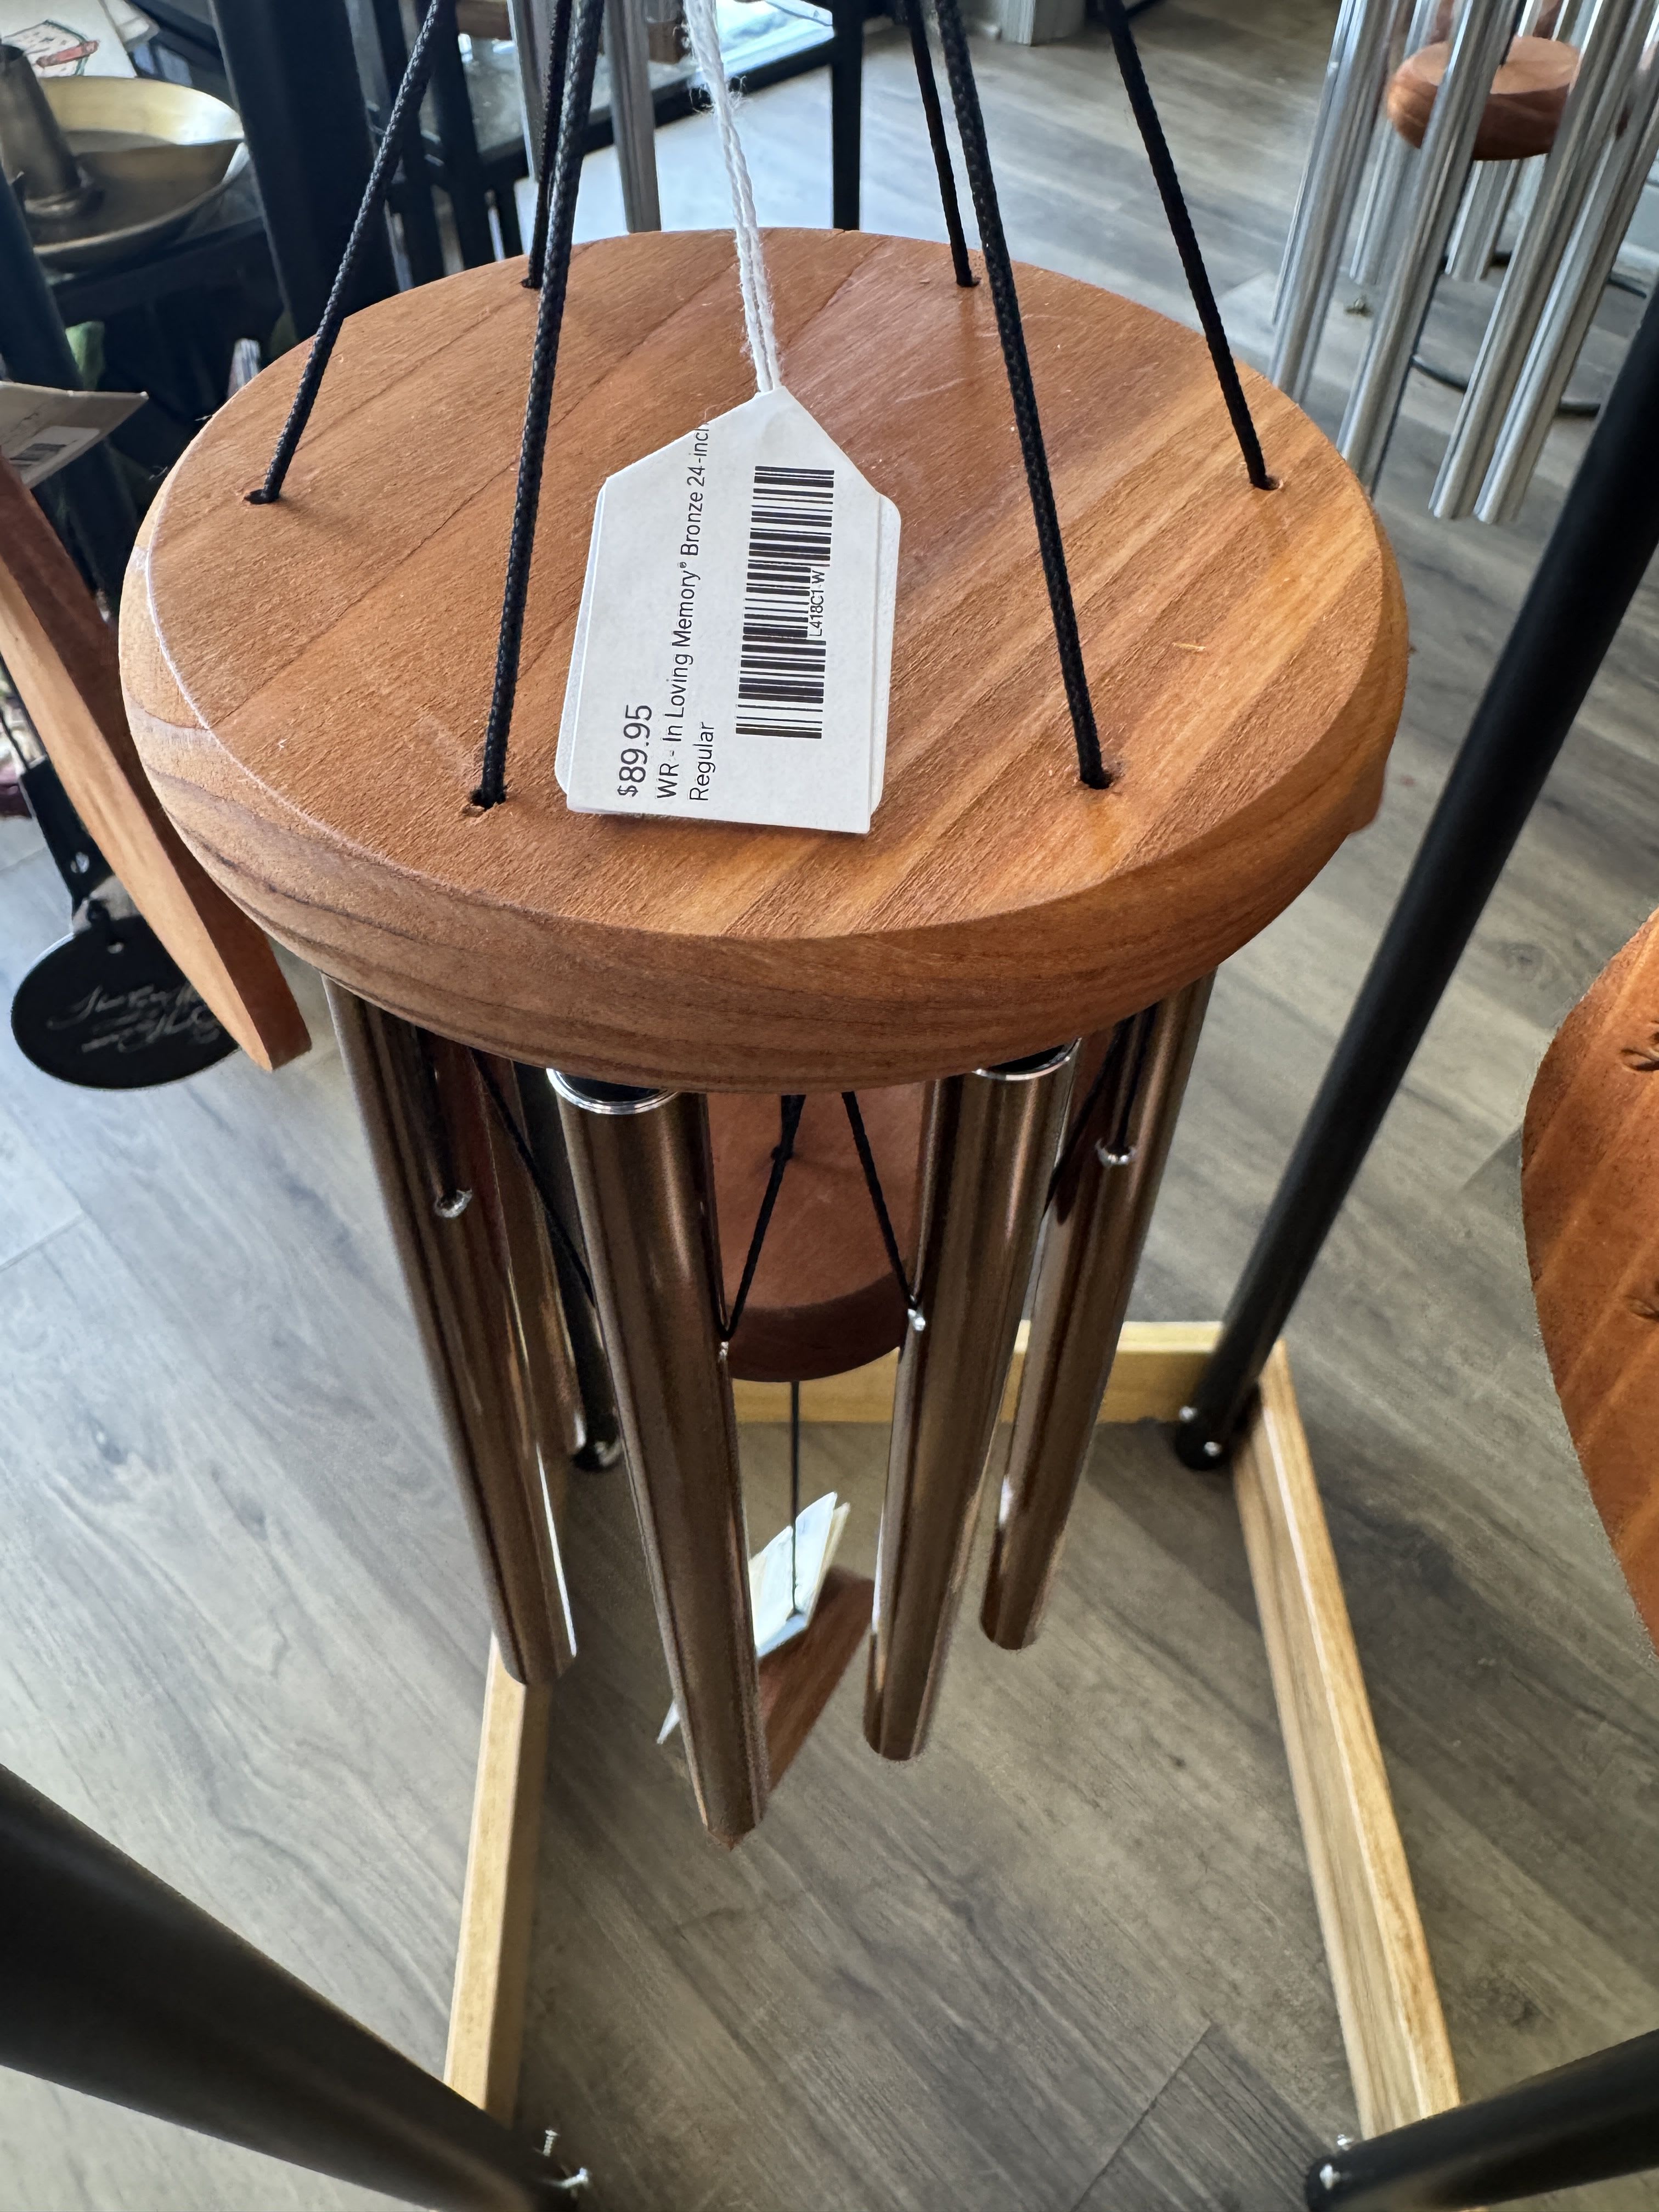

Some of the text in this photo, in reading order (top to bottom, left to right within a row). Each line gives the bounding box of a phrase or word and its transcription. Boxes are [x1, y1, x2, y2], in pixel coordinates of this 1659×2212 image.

[680, 492, 703, 556] Bronze
[664, 654, 694, 718] Loving
[617, 705, 652, 798] $89.95
[662, 725, 683, 742] In
[690, 721, 716, 801] Regular
[657, 763, 680, 799] WR
